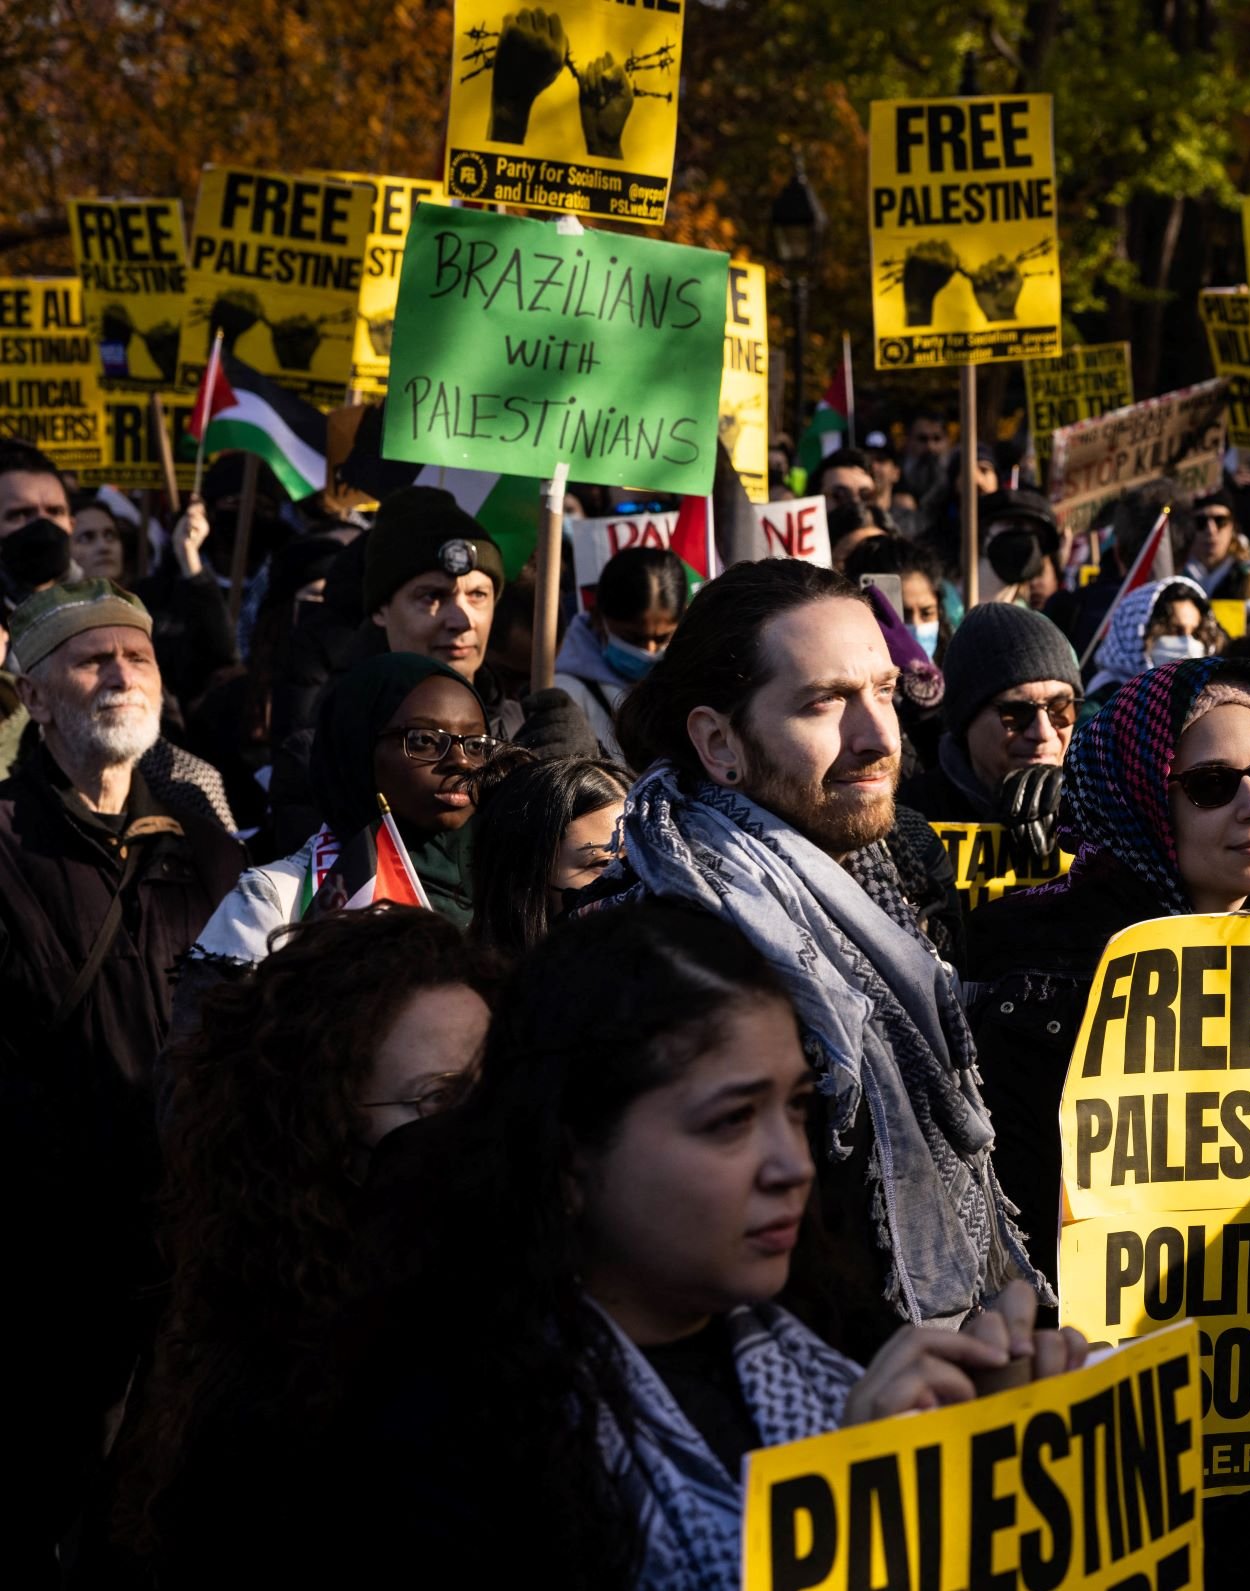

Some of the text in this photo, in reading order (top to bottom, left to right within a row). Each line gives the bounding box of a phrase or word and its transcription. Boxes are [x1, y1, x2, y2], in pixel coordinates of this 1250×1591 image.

[895, 101, 1033, 174] FREE
[494, 184, 591, 211] and Liberation
[496, 157, 536, 183] Party
[540, 161, 564, 183] for
[567, 166, 623, 192] Socialism
[220, 172, 353, 246] FREE
[873, 178, 1054, 229] PALESTINE
[77, 204, 179, 261] FREE
[80, 263, 187, 294] PALESTINE
[193, 236, 363, 292] PALESTINE
[769, 1353, 1197, 1591] PALESTINE
